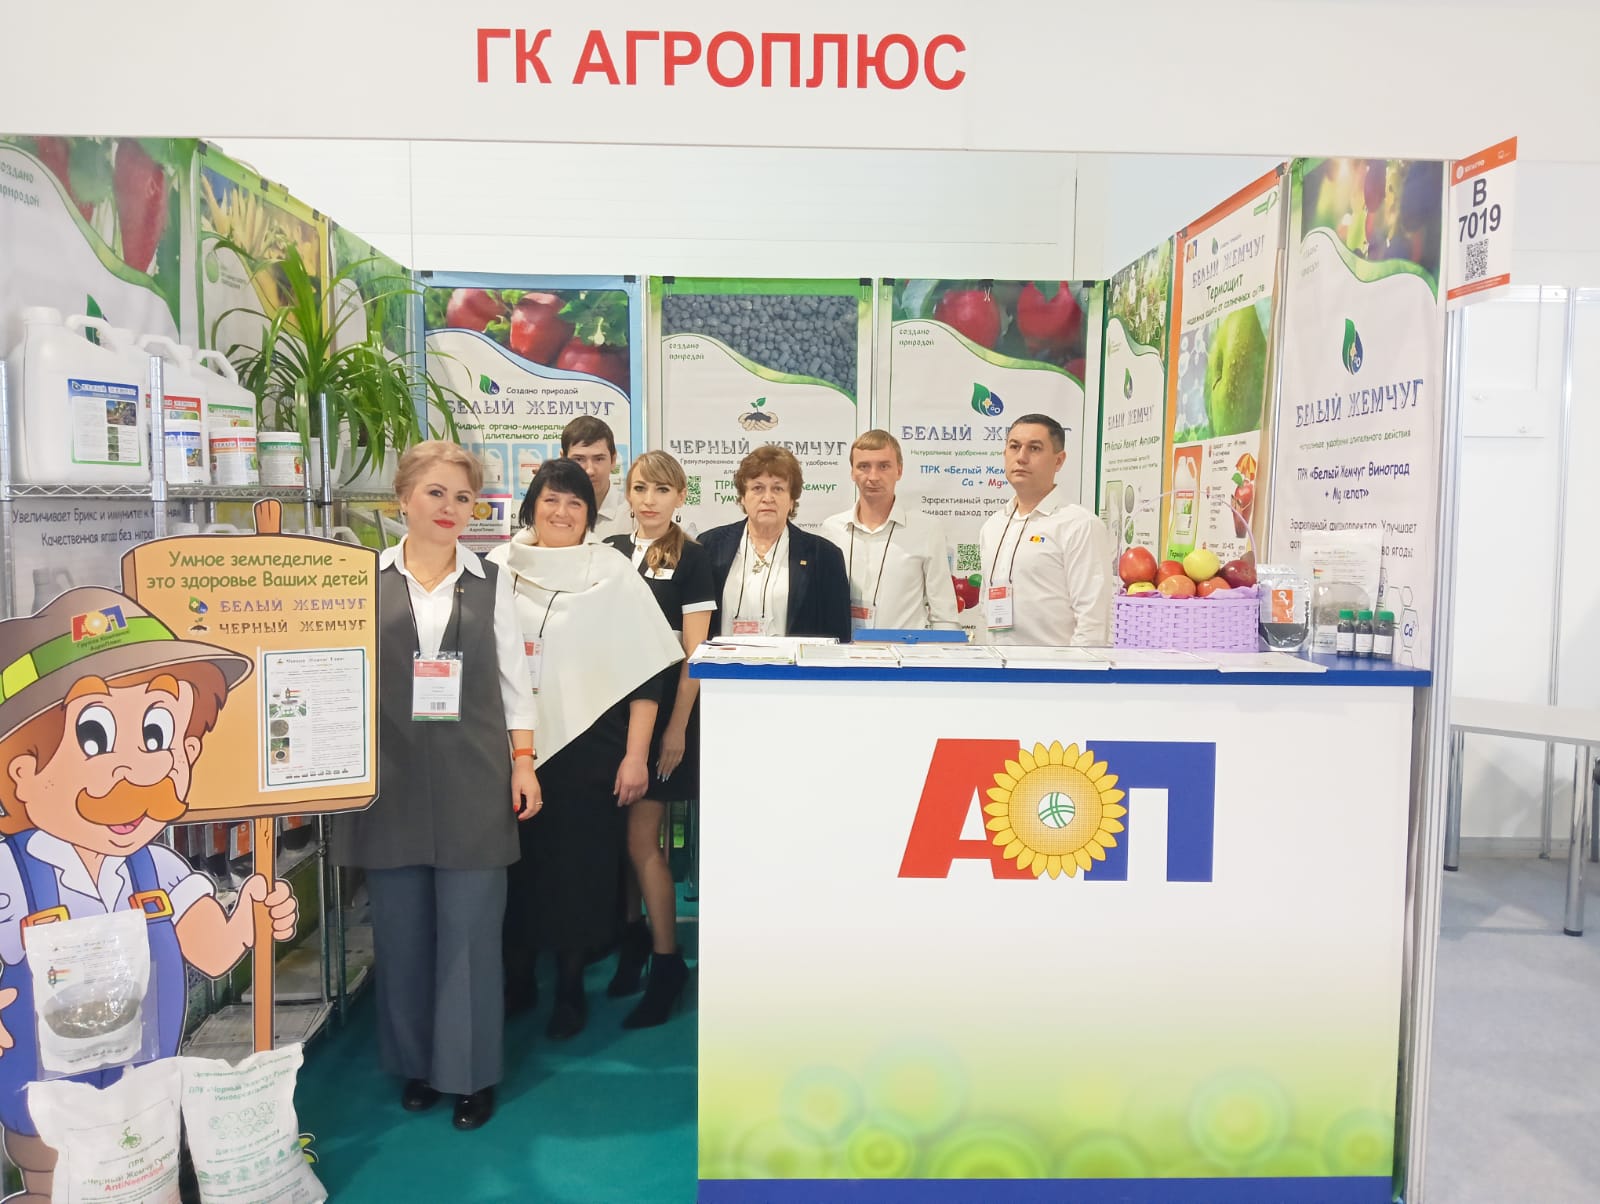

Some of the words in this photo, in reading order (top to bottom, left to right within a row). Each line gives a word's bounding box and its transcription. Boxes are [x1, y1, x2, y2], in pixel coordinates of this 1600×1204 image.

[477, 28, 552, 84] ГК
[572, 29, 966, 91] АГРОПЛЮС
[1458, 204, 1502, 243] 7019
[1206, 274, 1244, 303] Термощит
[506, 387, 538, 395] Создано
[541, 386, 578, 396] природой
[527, 401, 615, 416] ЖЕМЧУГ
[1296, 392, 1342, 428] БЕЛЫЙ
[1347, 378, 1424, 418] ЖЕМЧУГ
[901, 424, 972, 441] БЕЛЫЙ
[670, 437, 750, 455] ЧЕРНЫЙ
[806, 459, 839, 467] удобрение
[920, 465, 940, 474] ПРК
[944, 465, 982, 474] «Белый
[1368, 461, 1410, 480] Виноград
[921, 496, 981, 506] Эффективный
[12, 509, 71, 524] Увеличивает
[74, 508, 97, 525] Брикс
[1381, 519, 1417, 536] Улучшает
[42, 532, 99, 547] Качественная
[118, 529, 132, 541] без
[169, 551, 225, 567] Умное
[231, 553, 333, 569] земледелие
[147, 575, 176, 589] это
[181, 574, 257, 592] здоровье
[262, 570, 318, 587] Ваших
[321, 569, 369, 587] детей
[219, 598, 283, 613] БЕЛЫЙ
[292, 598, 367, 611] ЖЕМЧУГ
[219, 619, 288, 634] ЧЕРНЫЙ
[299, 619, 367, 632] ЖЕМЧУГ
